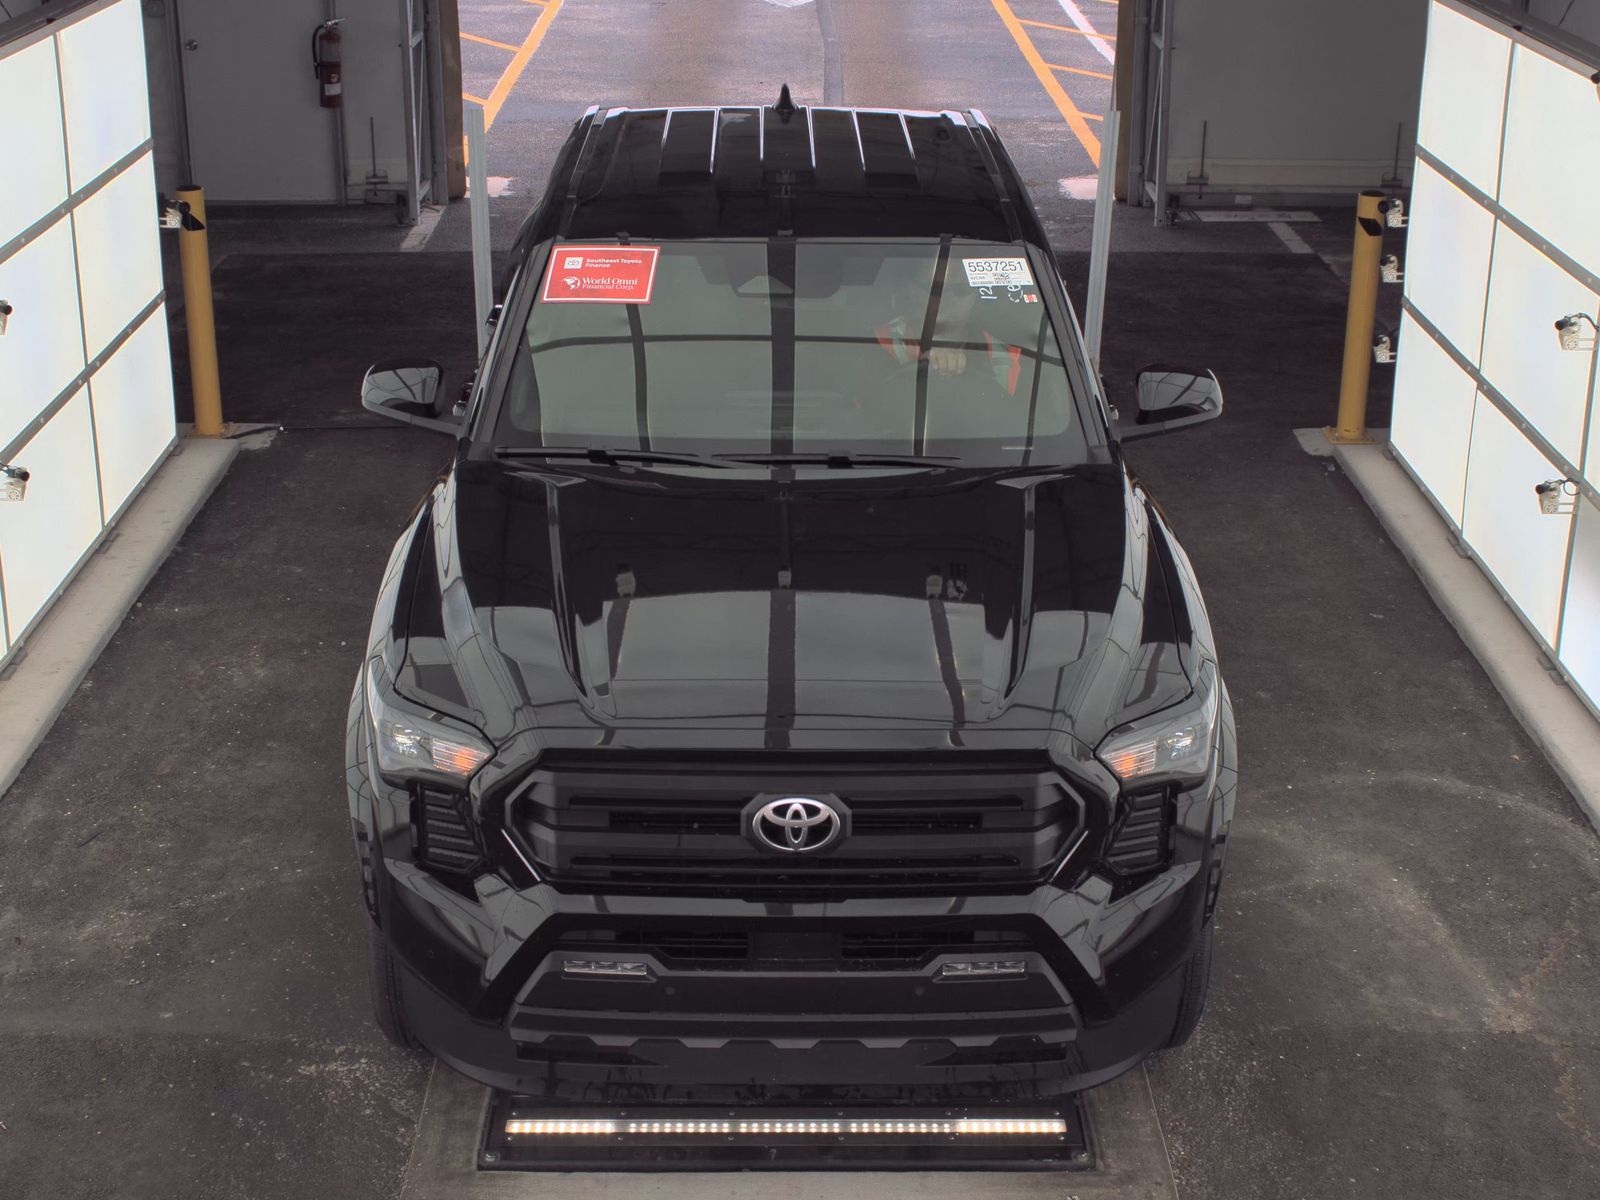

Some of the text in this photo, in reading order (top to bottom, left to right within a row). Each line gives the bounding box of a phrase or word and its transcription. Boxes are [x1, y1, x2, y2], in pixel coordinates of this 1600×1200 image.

[968, 261, 1023, 272] 5537251
[582, 277, 638, 285] World Omni
